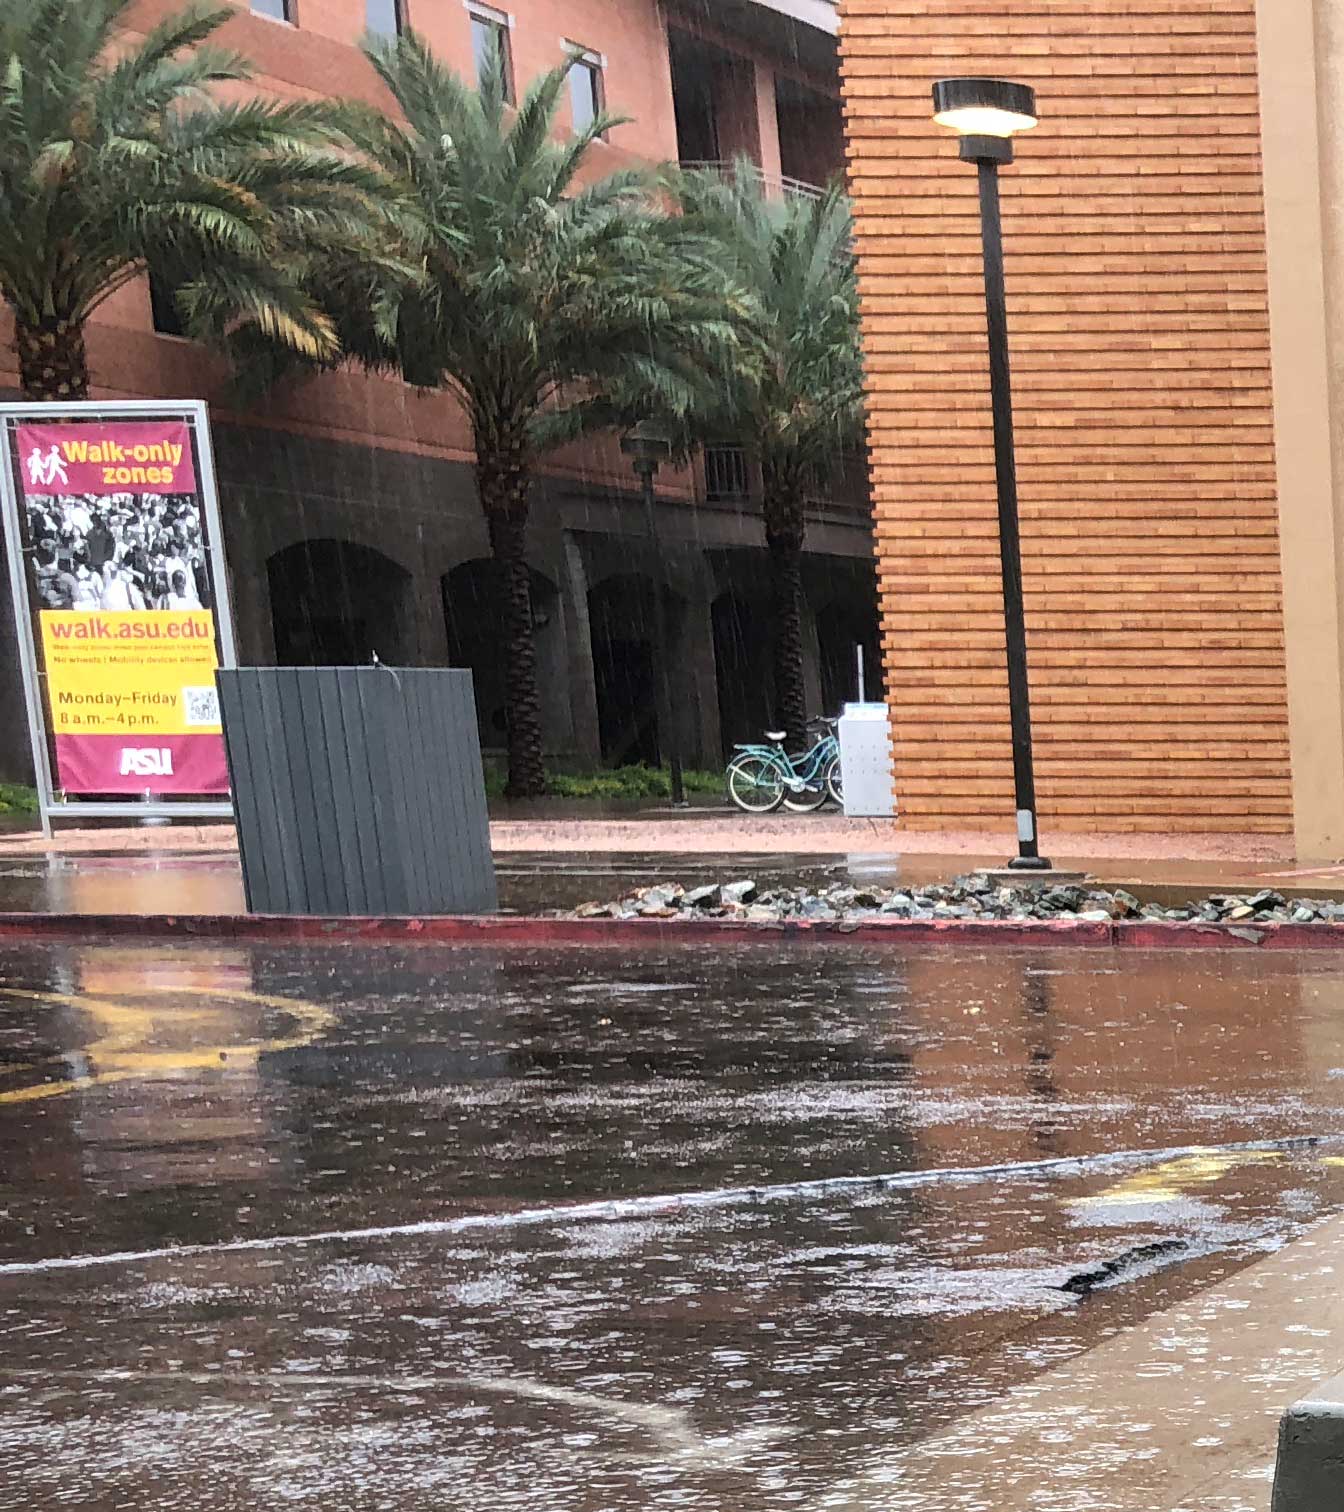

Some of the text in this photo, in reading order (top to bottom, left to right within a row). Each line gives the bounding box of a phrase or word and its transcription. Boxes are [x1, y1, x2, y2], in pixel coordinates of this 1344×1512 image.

[62, 440, 183, 467] Walk-only
[103, 466, 174, 485] zones
[50, 617, 209, 639] walk.asu.edu
[58, 691, 177, 706] Monday–Friday
[60, 712, 69, 725] 8
[120, 748, 174, 776] ASU
